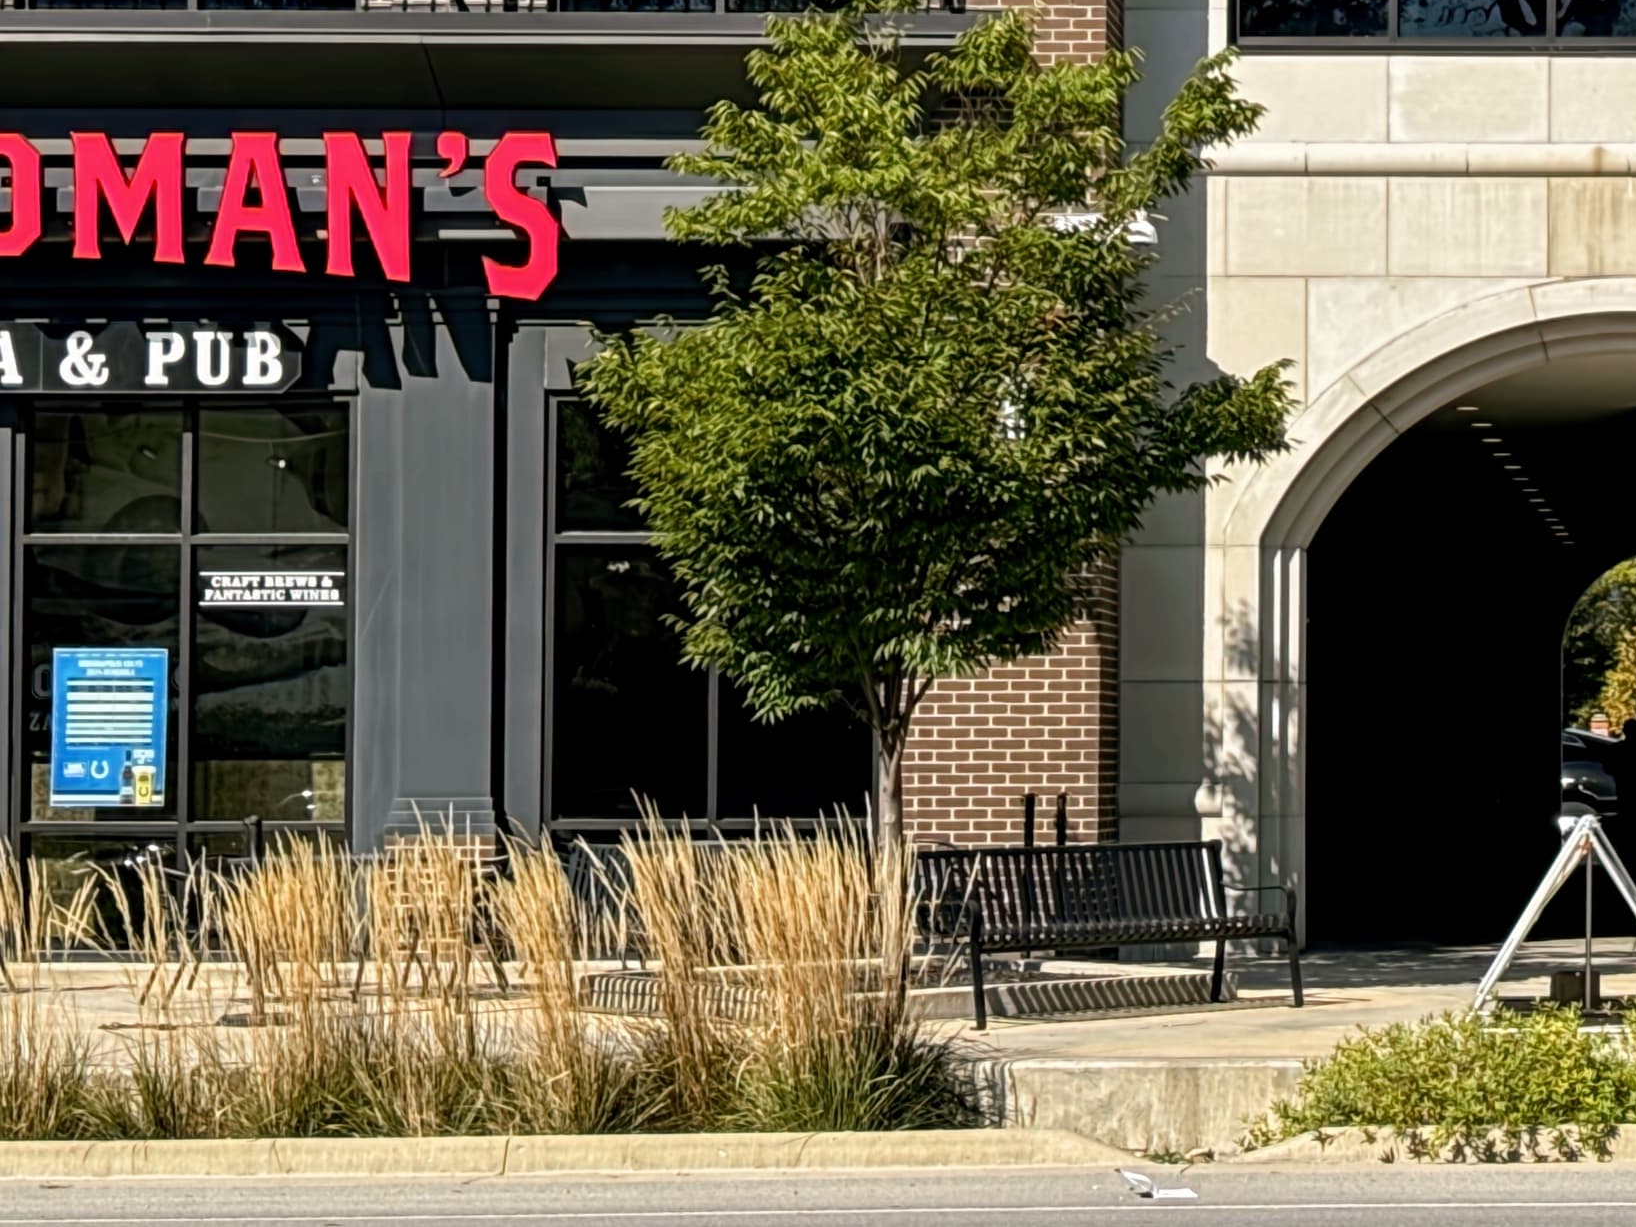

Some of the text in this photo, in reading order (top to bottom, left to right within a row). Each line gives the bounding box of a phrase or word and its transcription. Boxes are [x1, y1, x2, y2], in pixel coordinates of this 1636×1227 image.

[59, 330, 110, 386] &
[145, 330, 284, 386] PUB
[210, 576, 261, 588] CRAFT
[264, 576, 317, 588] BREWS
[204, 589, 340, 601] FANTASTIC WINES
